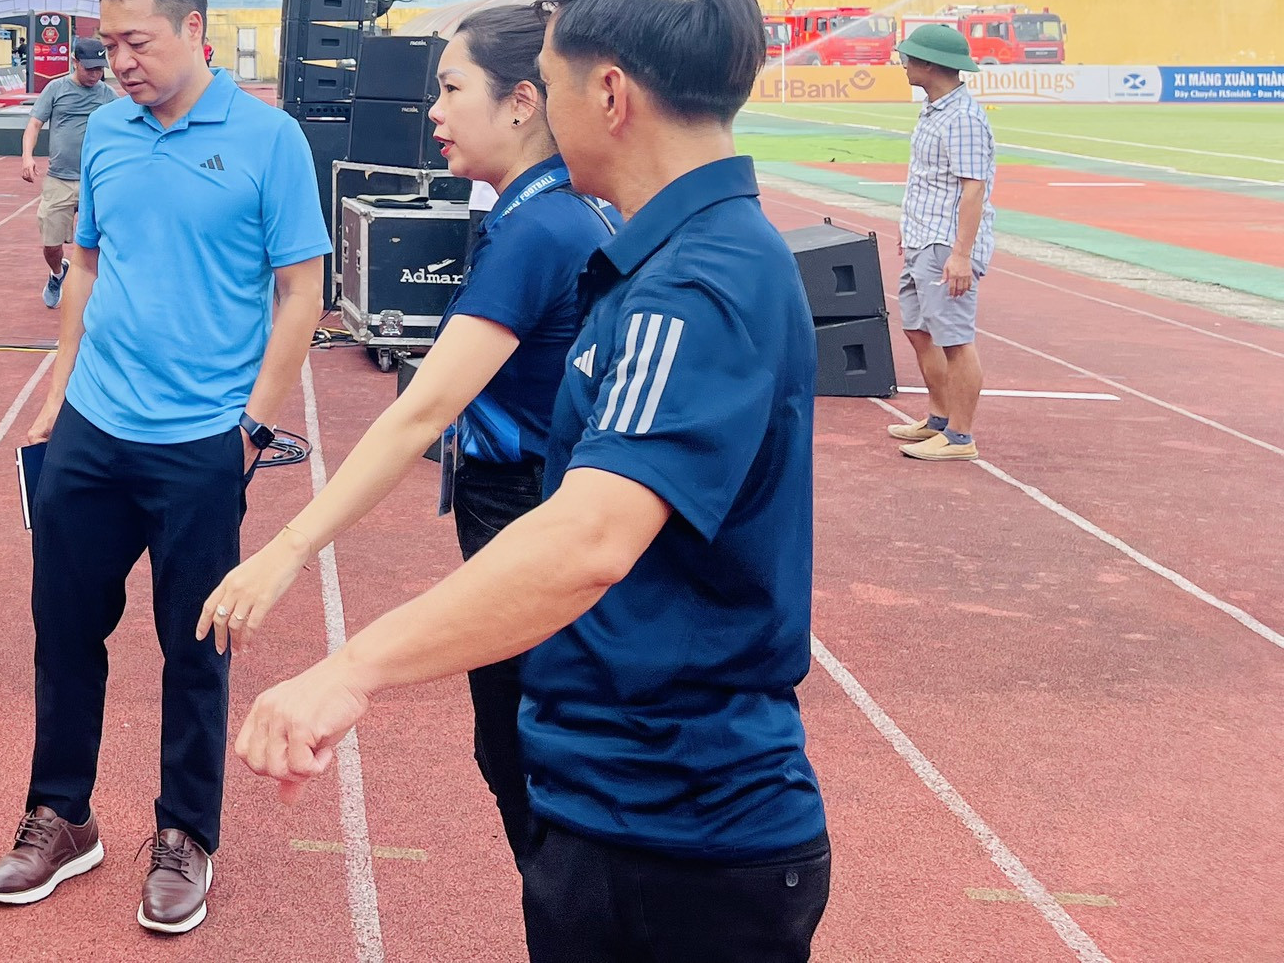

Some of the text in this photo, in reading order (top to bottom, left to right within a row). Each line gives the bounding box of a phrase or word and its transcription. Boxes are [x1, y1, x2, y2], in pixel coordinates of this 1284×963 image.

[1174, 73, 1186, 87] XI
[1188, 71, 1222, 87] MĂNG
[1224, 70, 1255, 87] XUÂN
[759, 79, 850, 99] LPBank
[519, 175, 556, 201] FOOTBALL
